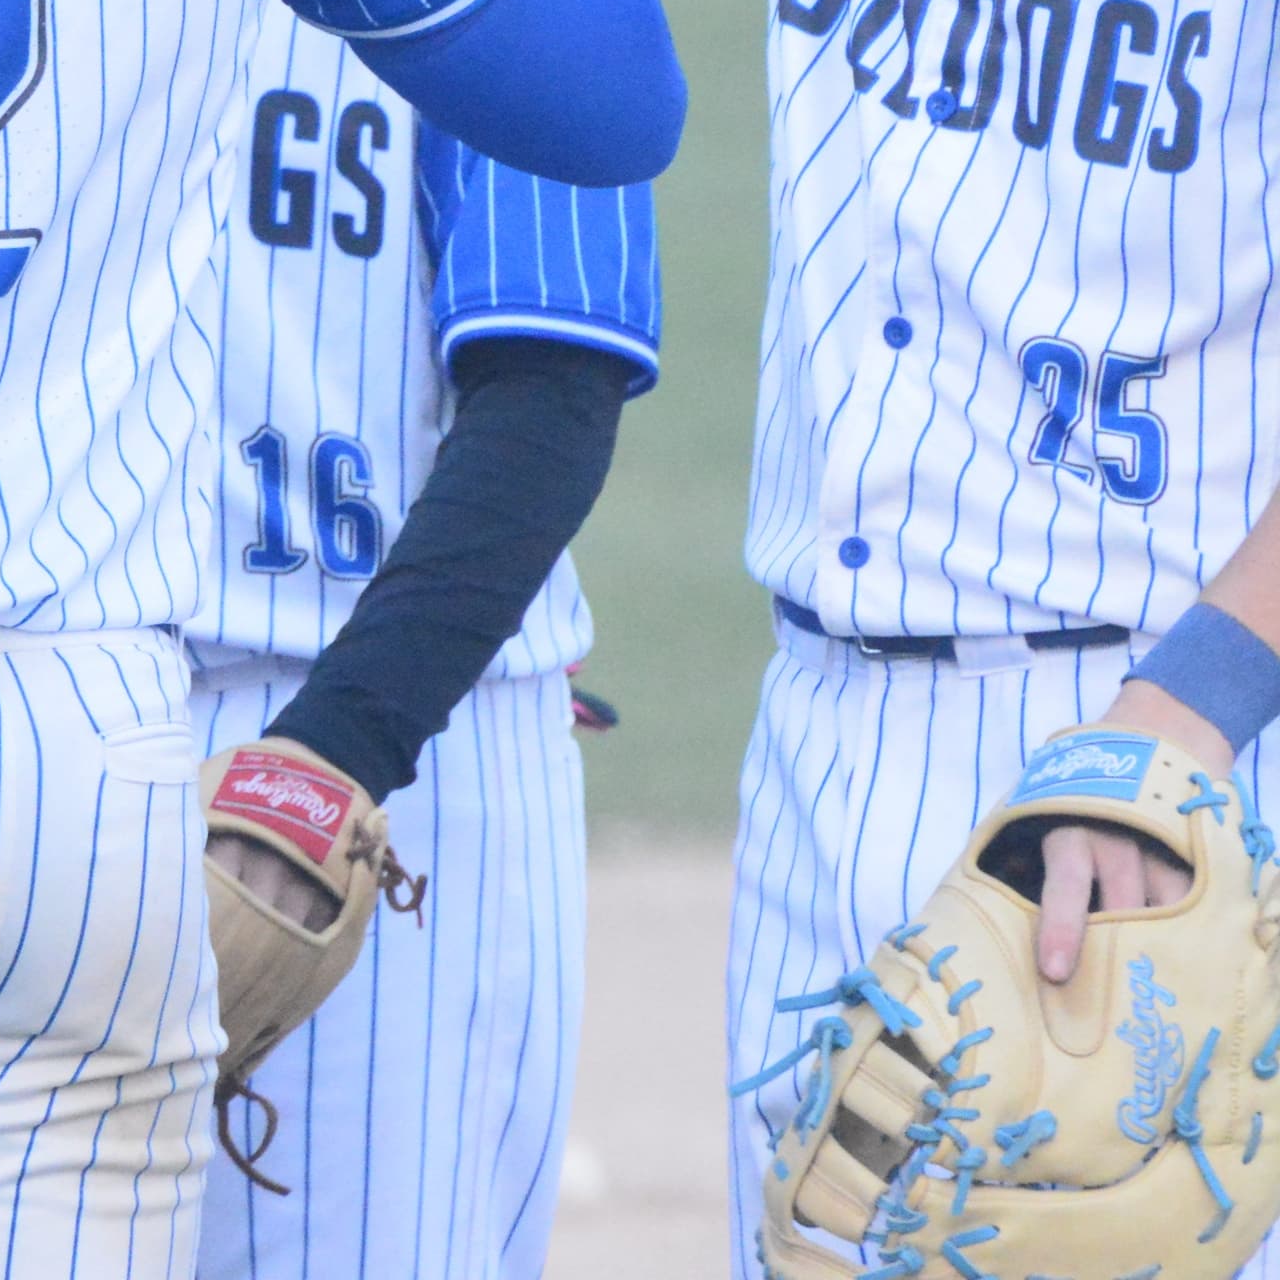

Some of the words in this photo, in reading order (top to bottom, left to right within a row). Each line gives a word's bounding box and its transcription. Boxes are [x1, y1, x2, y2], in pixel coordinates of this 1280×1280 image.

[239, 424, 384, 582] 16
[1017, 335, 1169, 507] 25
[232, 772, 340, 827] Rawlings
[1115, 953, 1178, 1145] Rawlings
